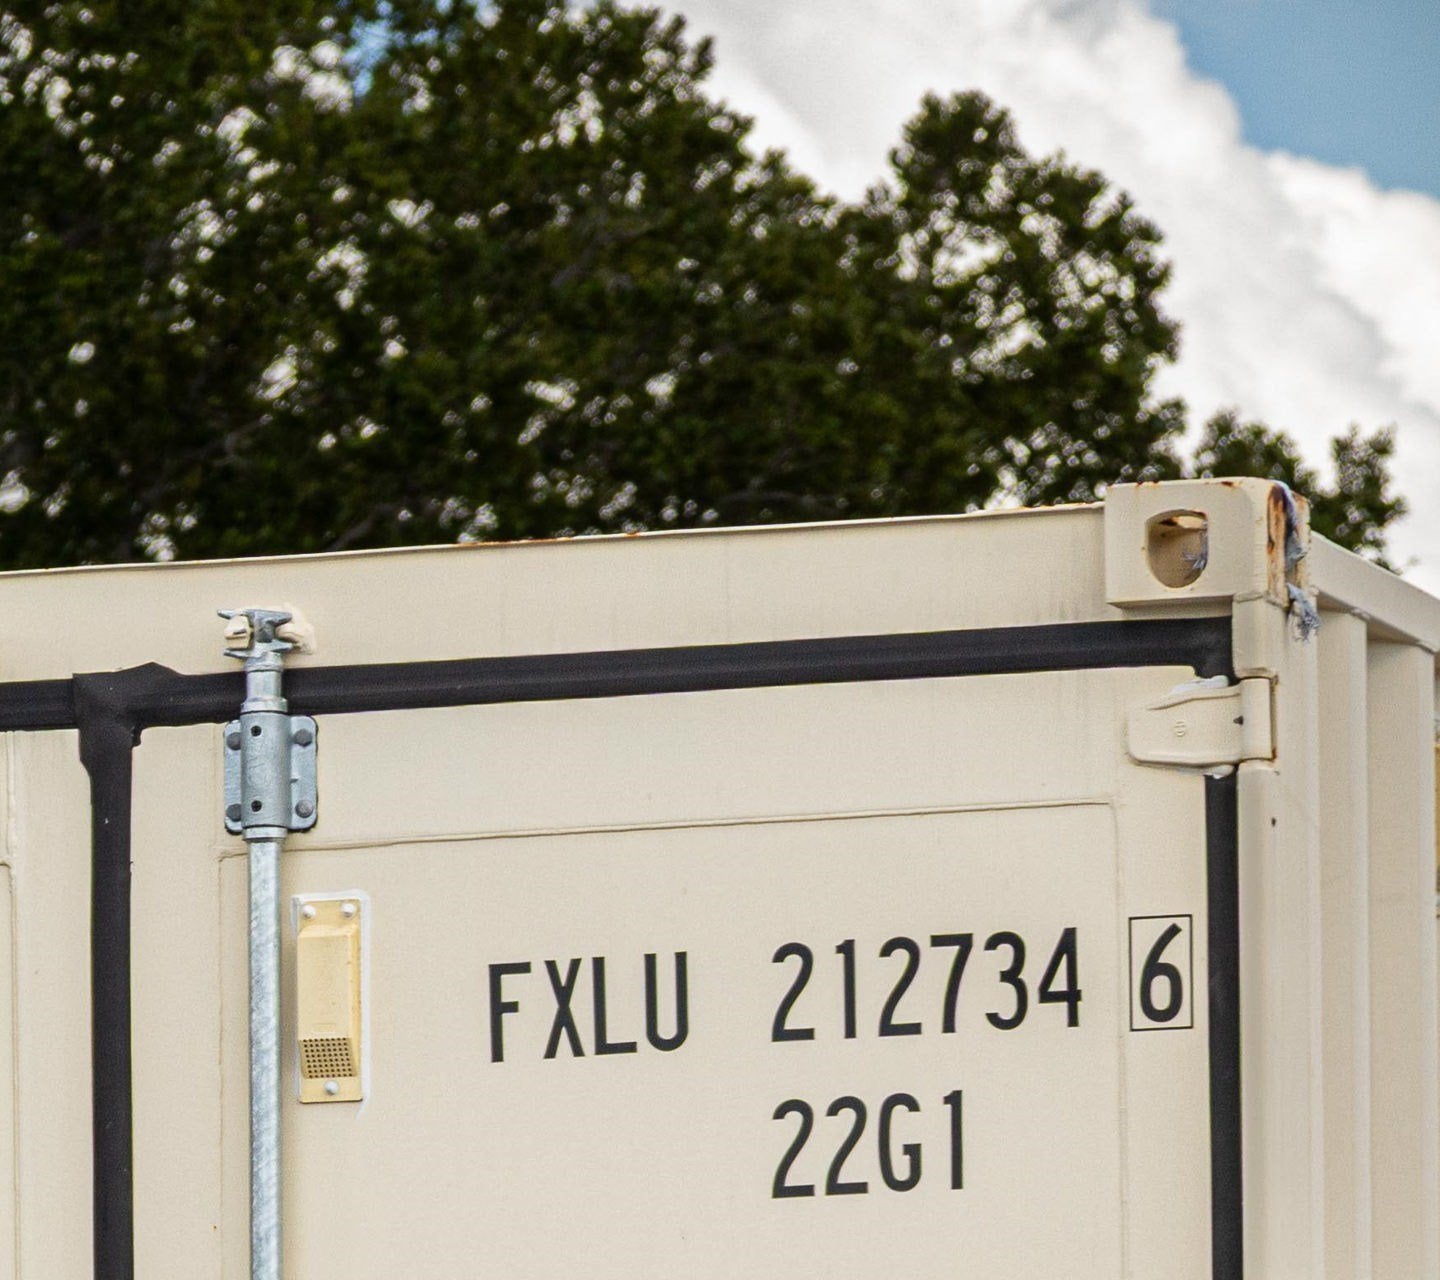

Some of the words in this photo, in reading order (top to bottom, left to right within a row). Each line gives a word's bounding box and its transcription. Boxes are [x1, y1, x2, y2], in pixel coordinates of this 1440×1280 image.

[489, 952, 688, 1062] FXLU
[772, 927, 1081, 1042] 212734
[1140, 922, 1182, 1022] 6
[772, 1090, 963, 1198] 22G1
